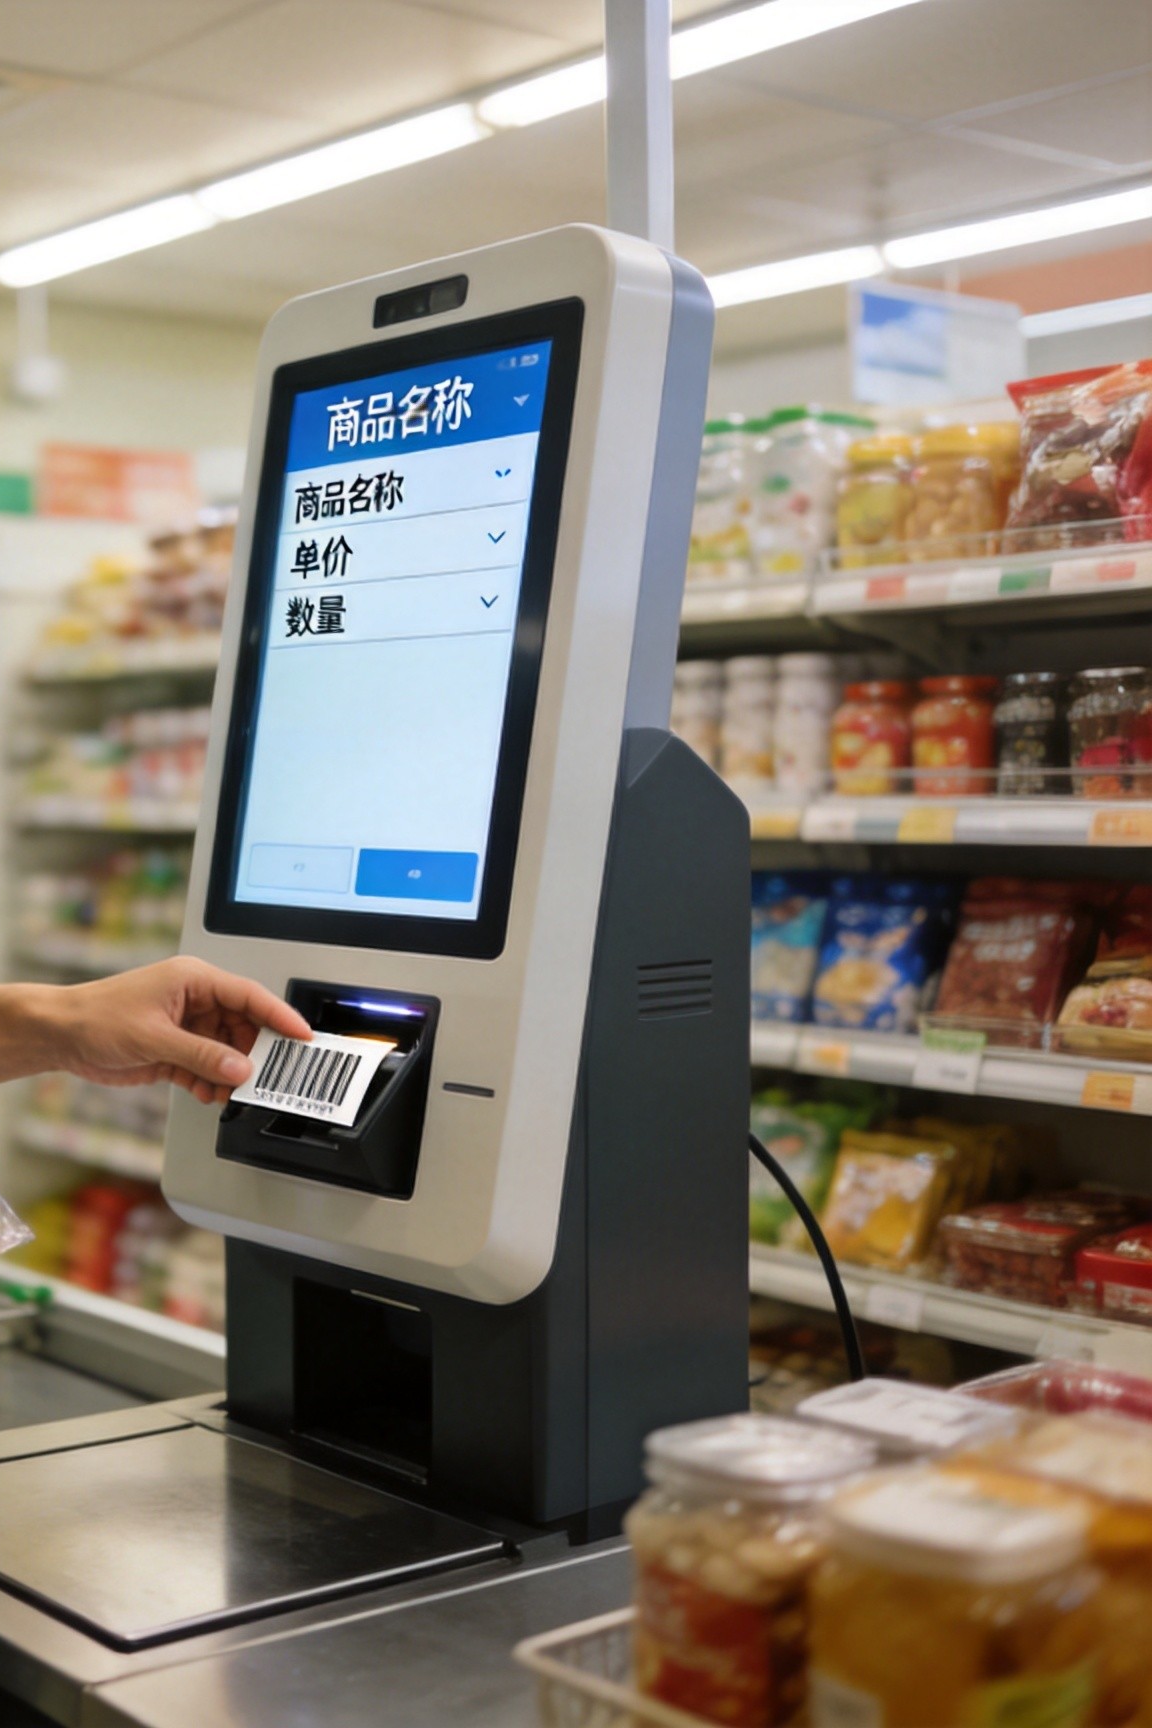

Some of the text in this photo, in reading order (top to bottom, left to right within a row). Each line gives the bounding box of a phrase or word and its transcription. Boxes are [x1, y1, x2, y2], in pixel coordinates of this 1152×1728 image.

[327, 376, 473, 451] 商品名称
[294, 470, 404, 524] 商品名称
[291, 535, 353, 579] 单价
[285, 595, 346, 637] 数量
